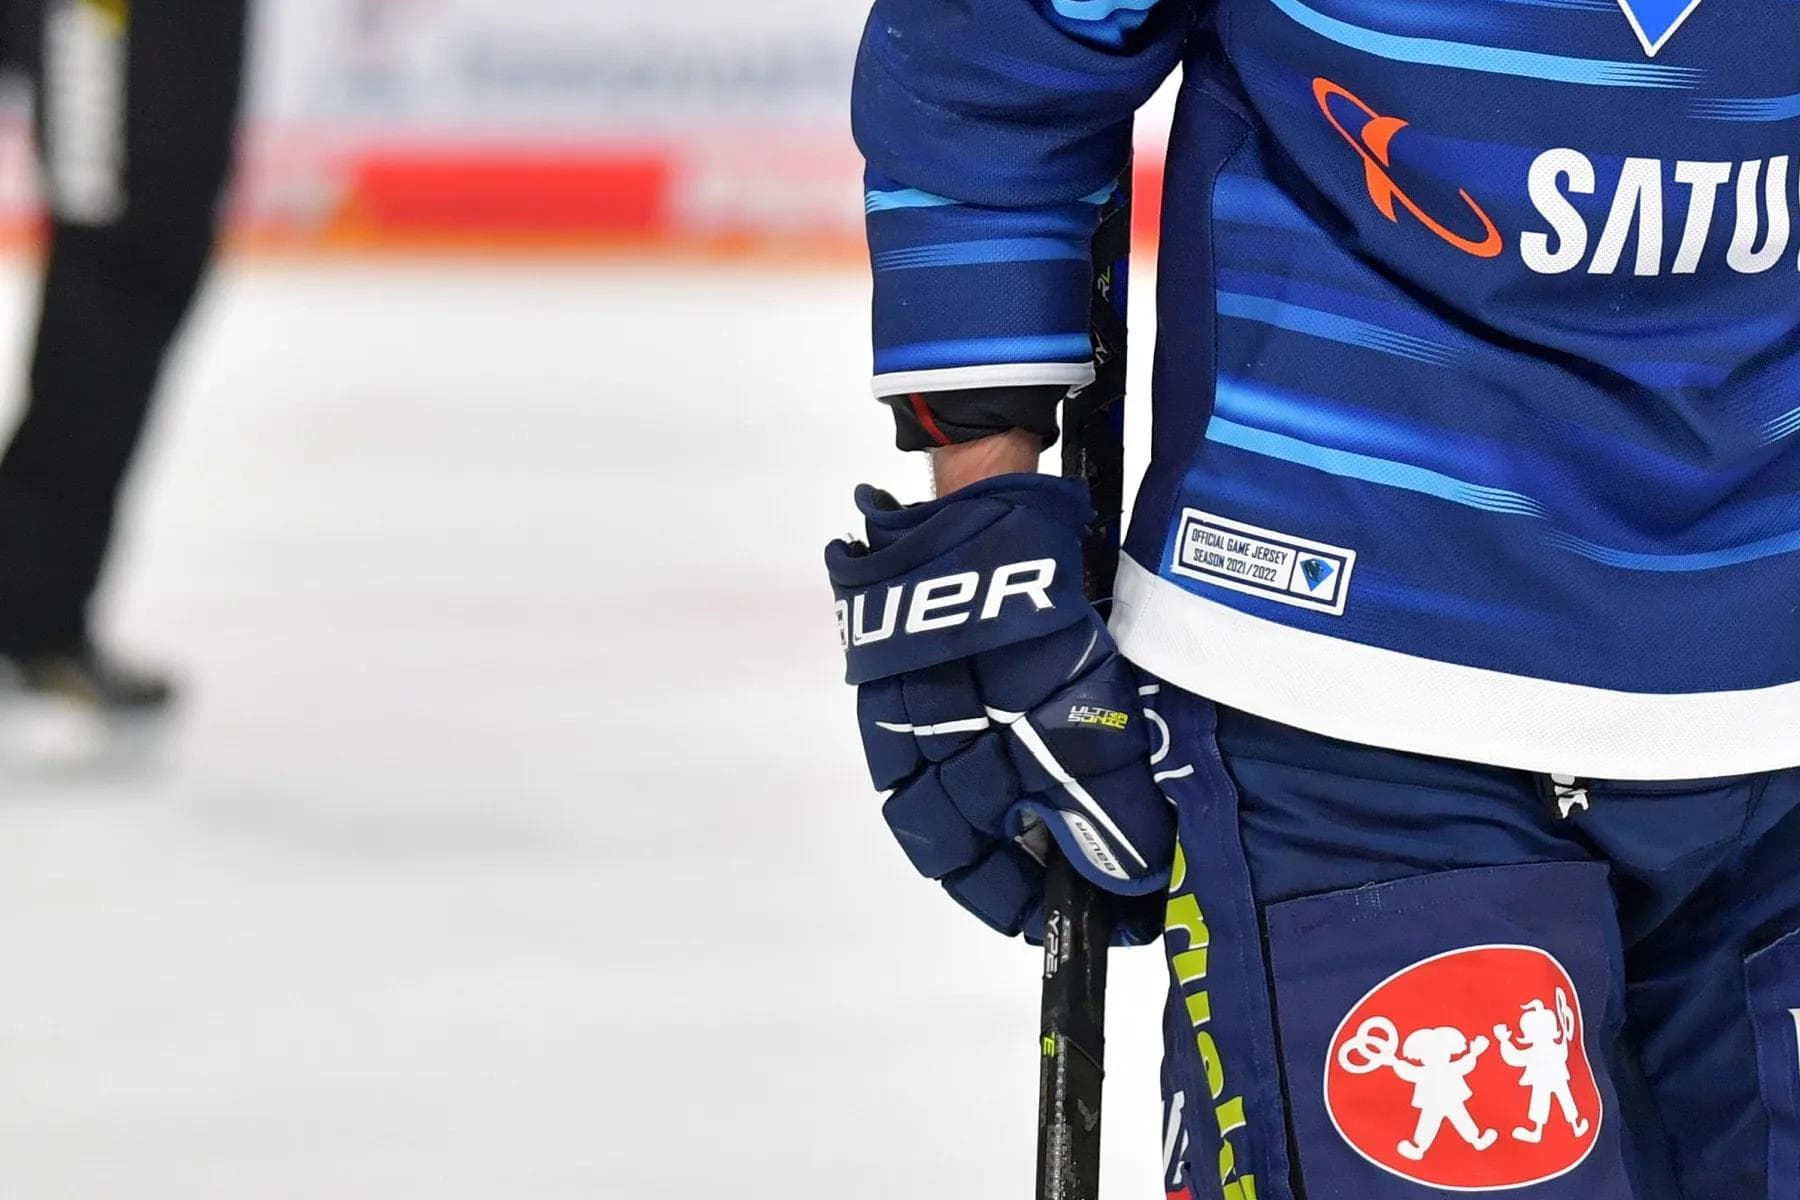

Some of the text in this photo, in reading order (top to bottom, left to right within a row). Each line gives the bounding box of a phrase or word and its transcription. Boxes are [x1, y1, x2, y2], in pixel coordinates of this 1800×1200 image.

[1192, 528, 1288, 566] OFFICIAL GAME JERSEY
[1193, 547, 1277, 582] SEASON 2021/2022
